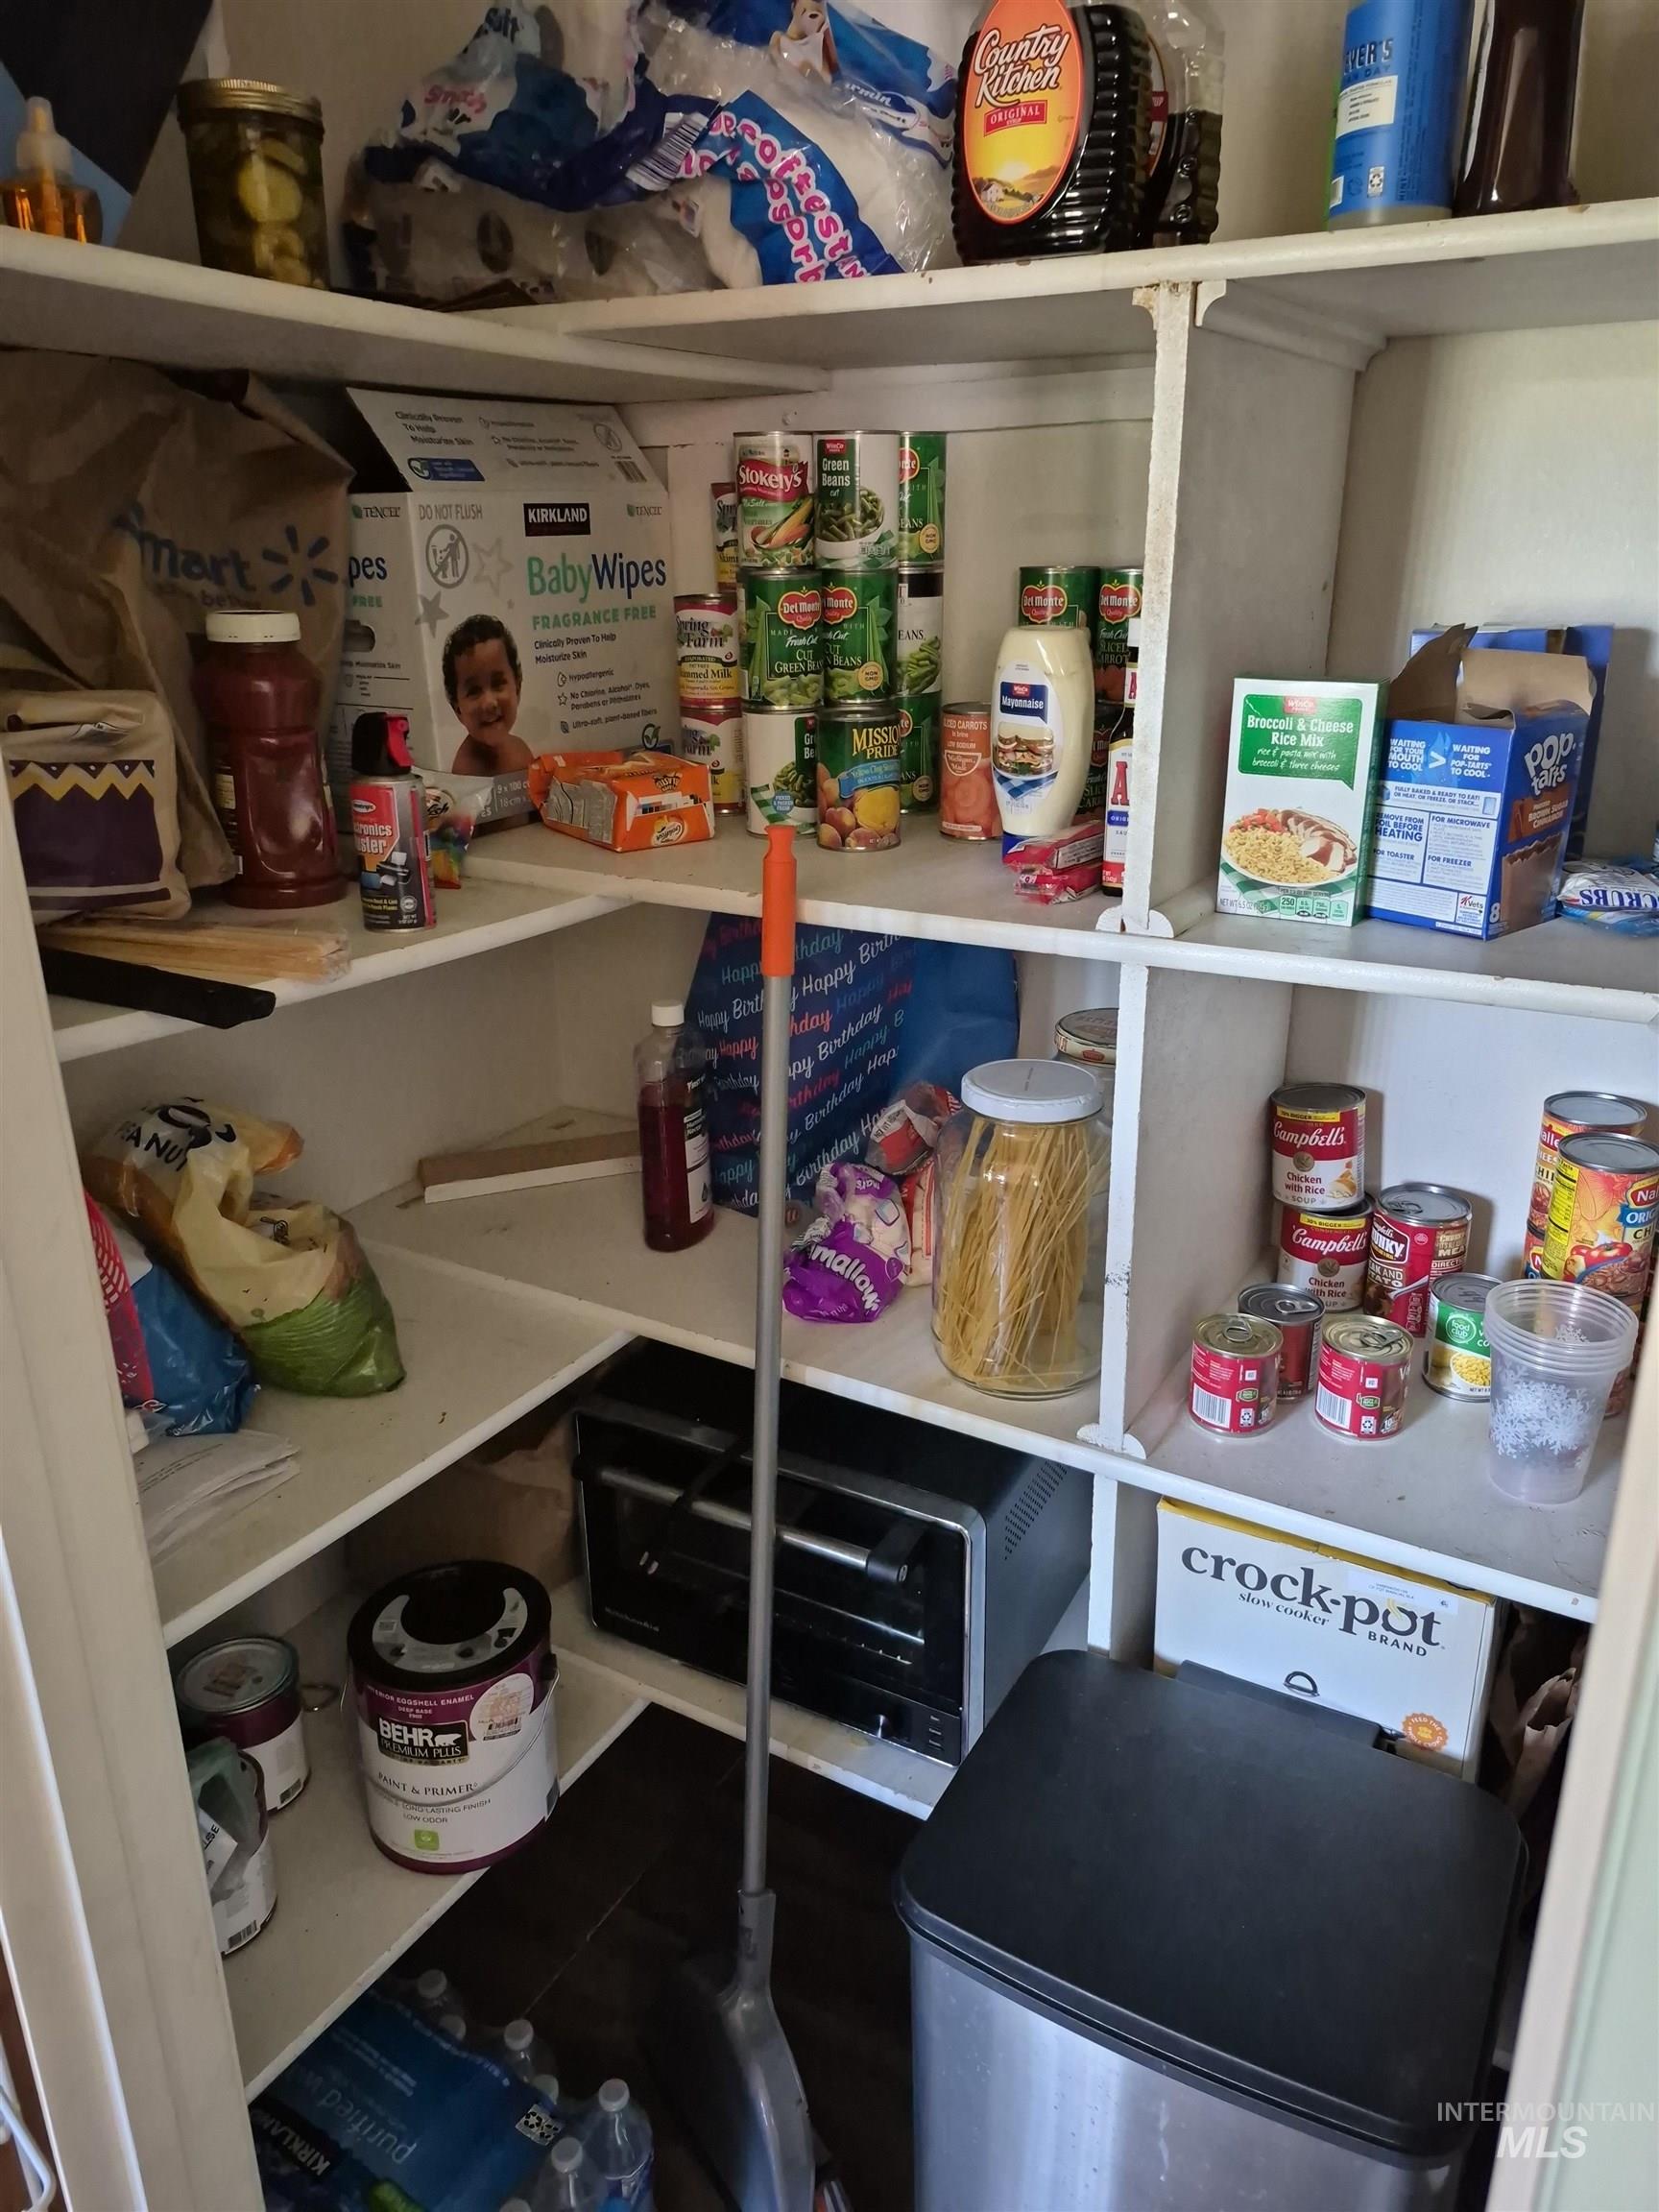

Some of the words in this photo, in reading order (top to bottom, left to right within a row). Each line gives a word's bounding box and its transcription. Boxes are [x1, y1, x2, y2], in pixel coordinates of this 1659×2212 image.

[974, 24, 1070, 75] Country
[974, 63, 1060, 108] Kitchen
[991, 106, 1040, 125] ORIGINAL
[822, 458, 850, 471] Green
[738, 465, 803, 493] Stokely's
[822, 473, 851, 488] Beans
[364, 506, 400, 518] TENCEL
[419, 505, 433, 520] DO
[435, 504, 453, 519] NOT
[456, 504, 483, 519] FLUSH
[528, 507, 587, 523] KIRKLAND
[349, 556, 387, 588] pes
[783, 602, 799, 613] Del
[827, 597, 854, 609] Monte
[1023, 595, 1034, 606] Del
[1035, 595, 1064, 607] Monte
[1110, 595, 1138, 607] Monte
[533, 610, 619, 630] FRAGRANCE
[624, 605, 657, 621] FREE
[676, 614, 709, 636] Spring
[685, 633, 723, 648] Farm
[899, 630, 925, 640] EANS
[1099, 628, 1114, 638] Fresh
[534, 638, 565, 650] Clinically
[566, 636, 590, 646] Proven
[601, 633, 616, 642] Help
[785, 635, 806, 648] Fresh
[535, 653, 571, 664] Moisturize
[573, 650, 588, 660] Skin
[796, 648, 814, 661] CUT
[833, 654, 862, 666] BEANS
[710, 667, 733, 678] Milk
[775, 661, 805, 673] GREEN
[1001, 695, 1044, 709] Mayonnaise
[957, 719, 988, 730] CARROTS
[1247, 715, 1293, 731] Broccoli
[1297, 717, 1307, 731] &
[1310, 718, 1354, 733] Cheese
[853, 725, 901, 757] MISSIO
[1271, 732, 1297, 746] Rice
[1300, 733, 1325, 747] Mix
[1389, 738, 1426, 749] WAITING
[866, 745, 899, 760] PRIDE
[1257, 748, 1271, 757] rice
[1280, 749, 1301, 758] pasta
[1319, 750, 1336, 759] with
[1453, 744, 1491, 755] WAITING
[1252, 757, 1279, 768] broccoli
[1289, 759, 1308, 769] three
[1310, 761, 1341, 771] cheeses
[1388, 753, 1424, 763] MOUTH
[1375, 819, 1391, 828] FOIL
[1394, 821, 1423, 832] BEFORE
[1447, 817, 1490, 829] MICROWAVE
[1375, 826, 1423, 842] HEATING
[1386, 851, 1415, 861] TOASTER
[1442, 856, 1472, 867] FREEZER
[1580, 888, 1659, 909] CRUBS
[1489, 902, 1500, 924] 8
[803, 960, 855, 997] Happy
[698, 1009, 729, 1033] Happy
[817, 1003, 882, 1060] Birthday
[720, 1036, 759, 1060] Happy
[805, 1072, 864, 1131] Birthday
[1274, 1120, 1345, 1149] Campbell's
[1542, 1130, 1560, 1148] alle
[796, 1131, 861, 1187] Birthday
[1286, 1171, 1322, 1184] Chicken
[1285, 1182, 1304, 1192] with
[1305, 1185, 1326, 1194] Rice
[1291, 1194, 1316, 1204] SOUP
[1292, 1226, 1367, 1254] Campbell's
[1368, 1270, 1404, 1287] TATO
[1382, 1267, 1403, 1281] AND
[1309, 1277, 1345, 1288] Chicken
[1306, 1286, 1326, 1297] with
[1327, 1287, 1347, 1298] Rice
[1451, 1328, 1468, 1337] club
[1452, 1319, 1470, 1332] food
[1181, 1546, 1441, 1647] crock-pot
[1238, 1592, 1275, 1612] slow
[1275, 1603, 1330, 1627] cooker
[1367, 1630, 1428, 1658] BRAND
[397, 1697, 438, 1707] EGGSHELL
[441, 1695, 474, 1706] ENAMEL
[1411, 1716, 1429, 1724] FEED
[1429, 1719, 1442, 1731] THE
[379, 1718, 434, 1747] BEHR
[380, 1738, 428, 1758] PREMIUM
[433, 1745, 462, 1761] PLUS
[378, 1771, 406, 1791] PAINT
[411, 1787, 420, 1795] &
[424, 1784, 474, 1796] PRIMER
[402, 1800, 423, 1813] LONG
[425, 1803, 461, 1815] LASTING
[463, 1798, 492, 1812] FINISH
[403, 1814, 421, 1822] LOW
[316, 2087, 418, 2165] purified
[262, 2114, 331, 2176] KIRKLAN
